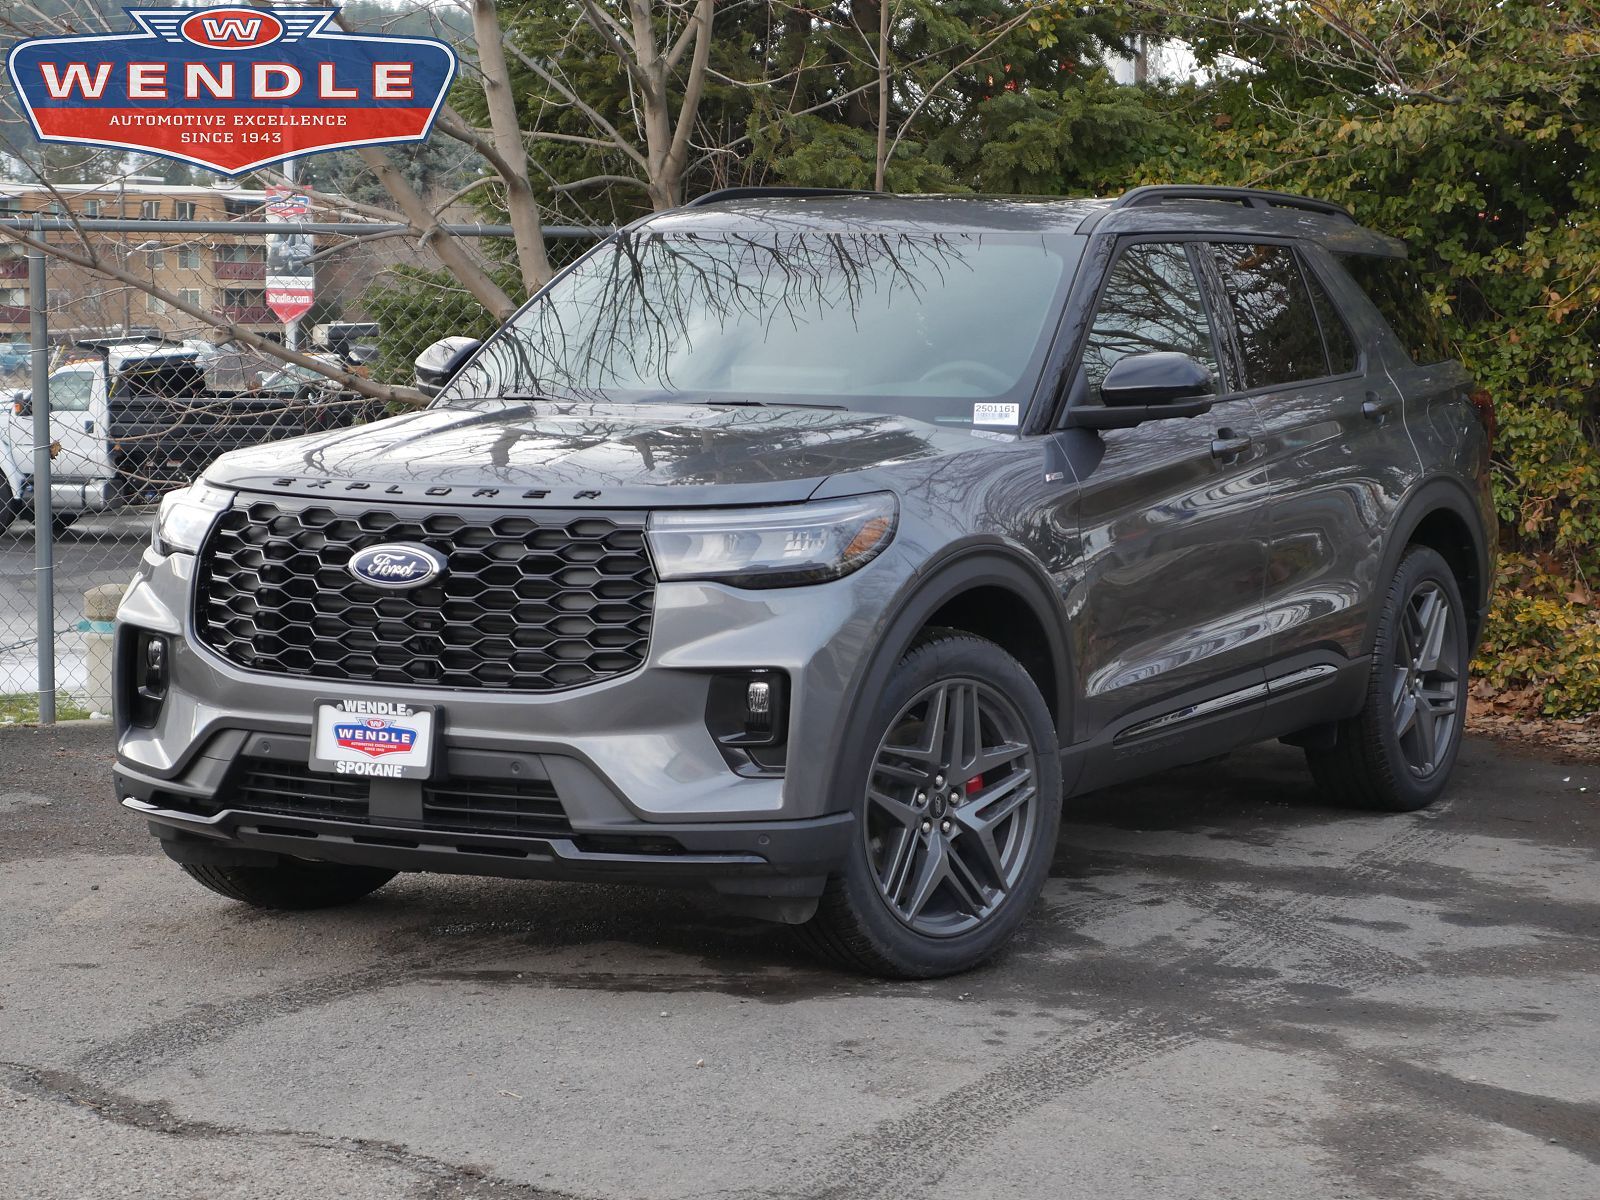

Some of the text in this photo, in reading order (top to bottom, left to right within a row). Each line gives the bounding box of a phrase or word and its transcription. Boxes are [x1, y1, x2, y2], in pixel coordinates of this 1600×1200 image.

[975, 404, 1016, 413] 2501161
[272, 477, 602, 500] EXPLORER
[367, 553, 416, 578] Ford
[343, 699, 407, 716] WENDLE
[338, 728, 411, 744] WENDLE
[336, 760, 402, 778] SPOKANE
